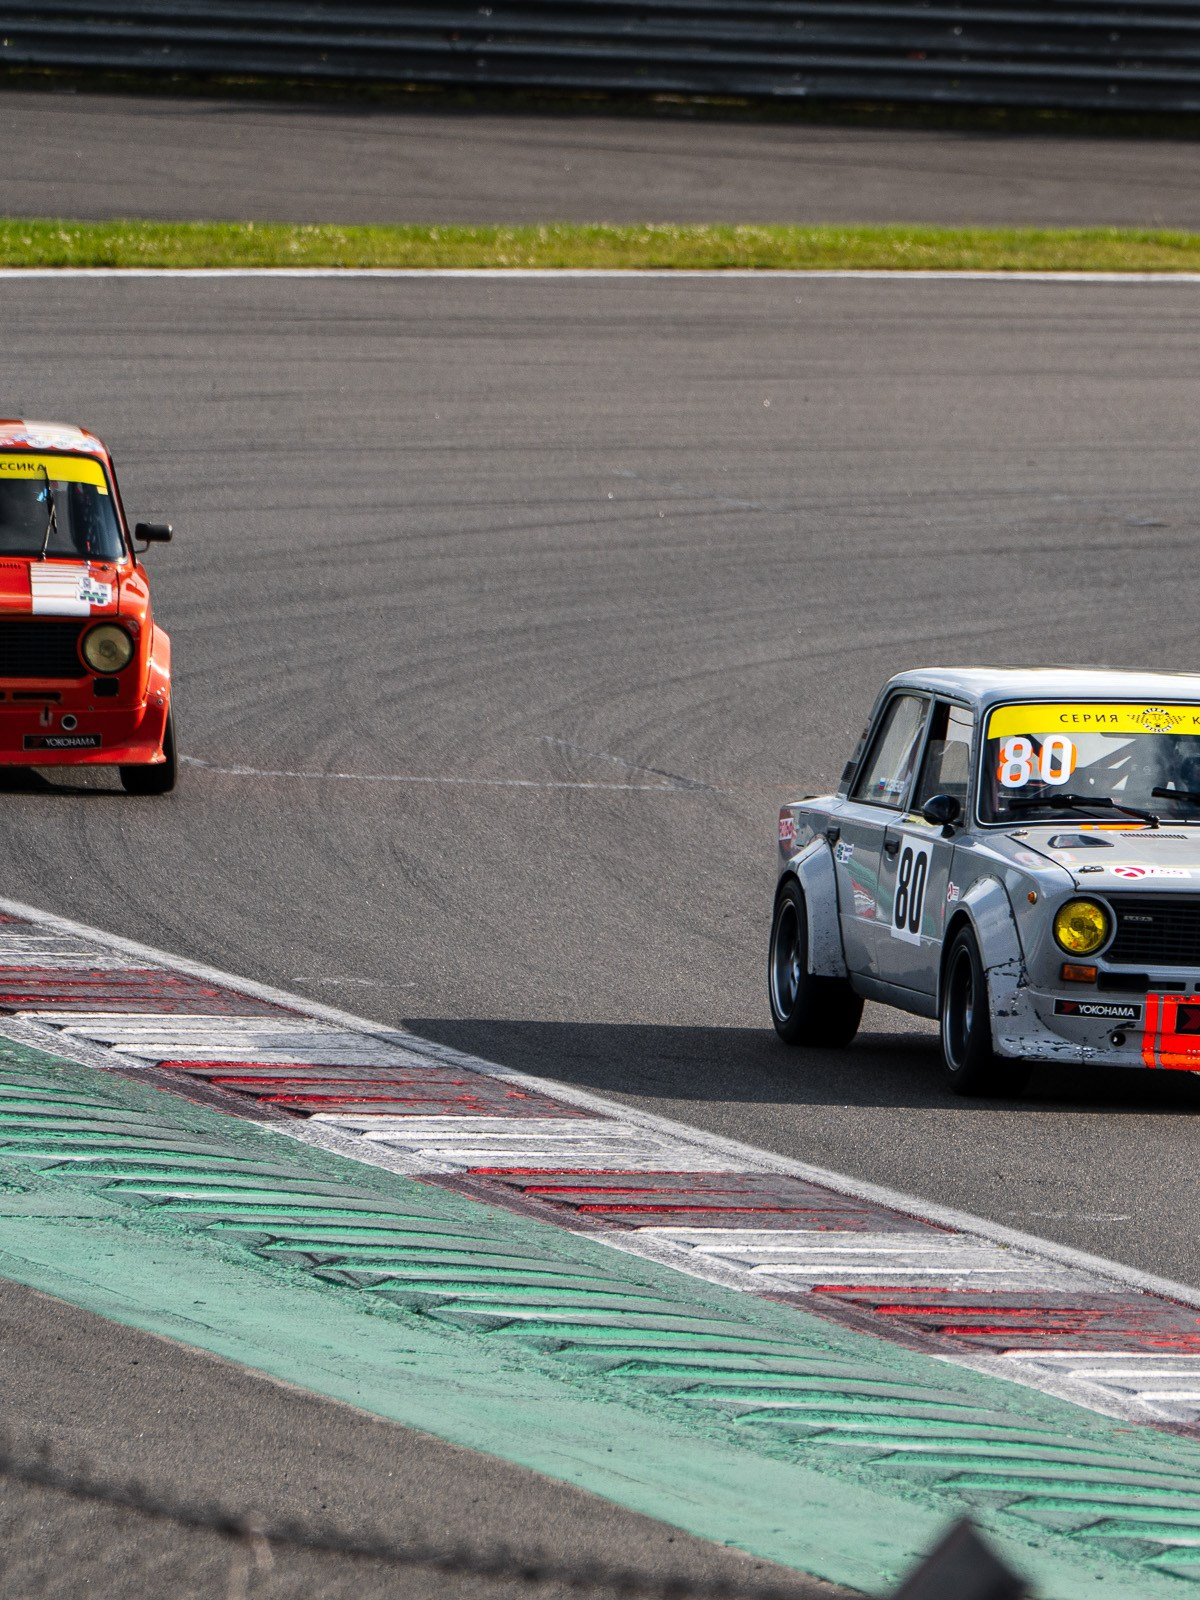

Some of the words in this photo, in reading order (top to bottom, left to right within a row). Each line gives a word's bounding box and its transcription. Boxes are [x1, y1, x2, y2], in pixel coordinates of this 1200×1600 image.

[1059, 713, 1119, 723] СЕРИЯ
[45, 737, 96, 747] YOKOHAMA
[998, 734, 1077, 788] 80
[894, 846, 928, 935] 80
[1078, 1004, 1135, 1017] YOKOHAMA
